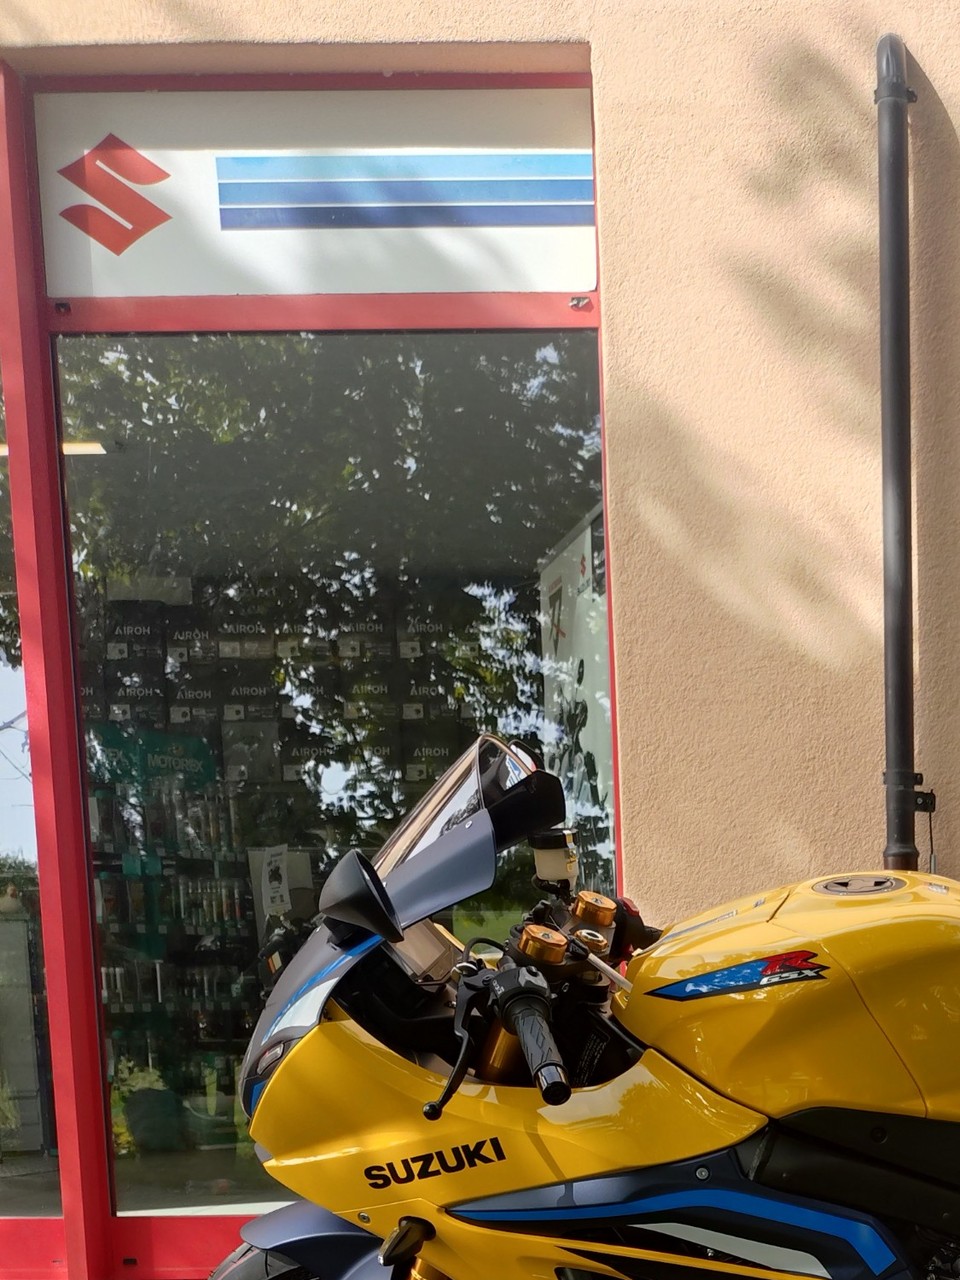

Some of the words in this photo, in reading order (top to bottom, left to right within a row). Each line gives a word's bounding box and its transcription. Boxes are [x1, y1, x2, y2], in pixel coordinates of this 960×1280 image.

[115, 625, 151, 637] AIROH
[176, 689, 212, 701] AIROH
[231, 686, 267, 697] AIROH
[413, 747, 449, 758] AIROH
[147, 752, 204, 773] MOTOREX
[363, 1137, 506, 1190] SUZUKI
